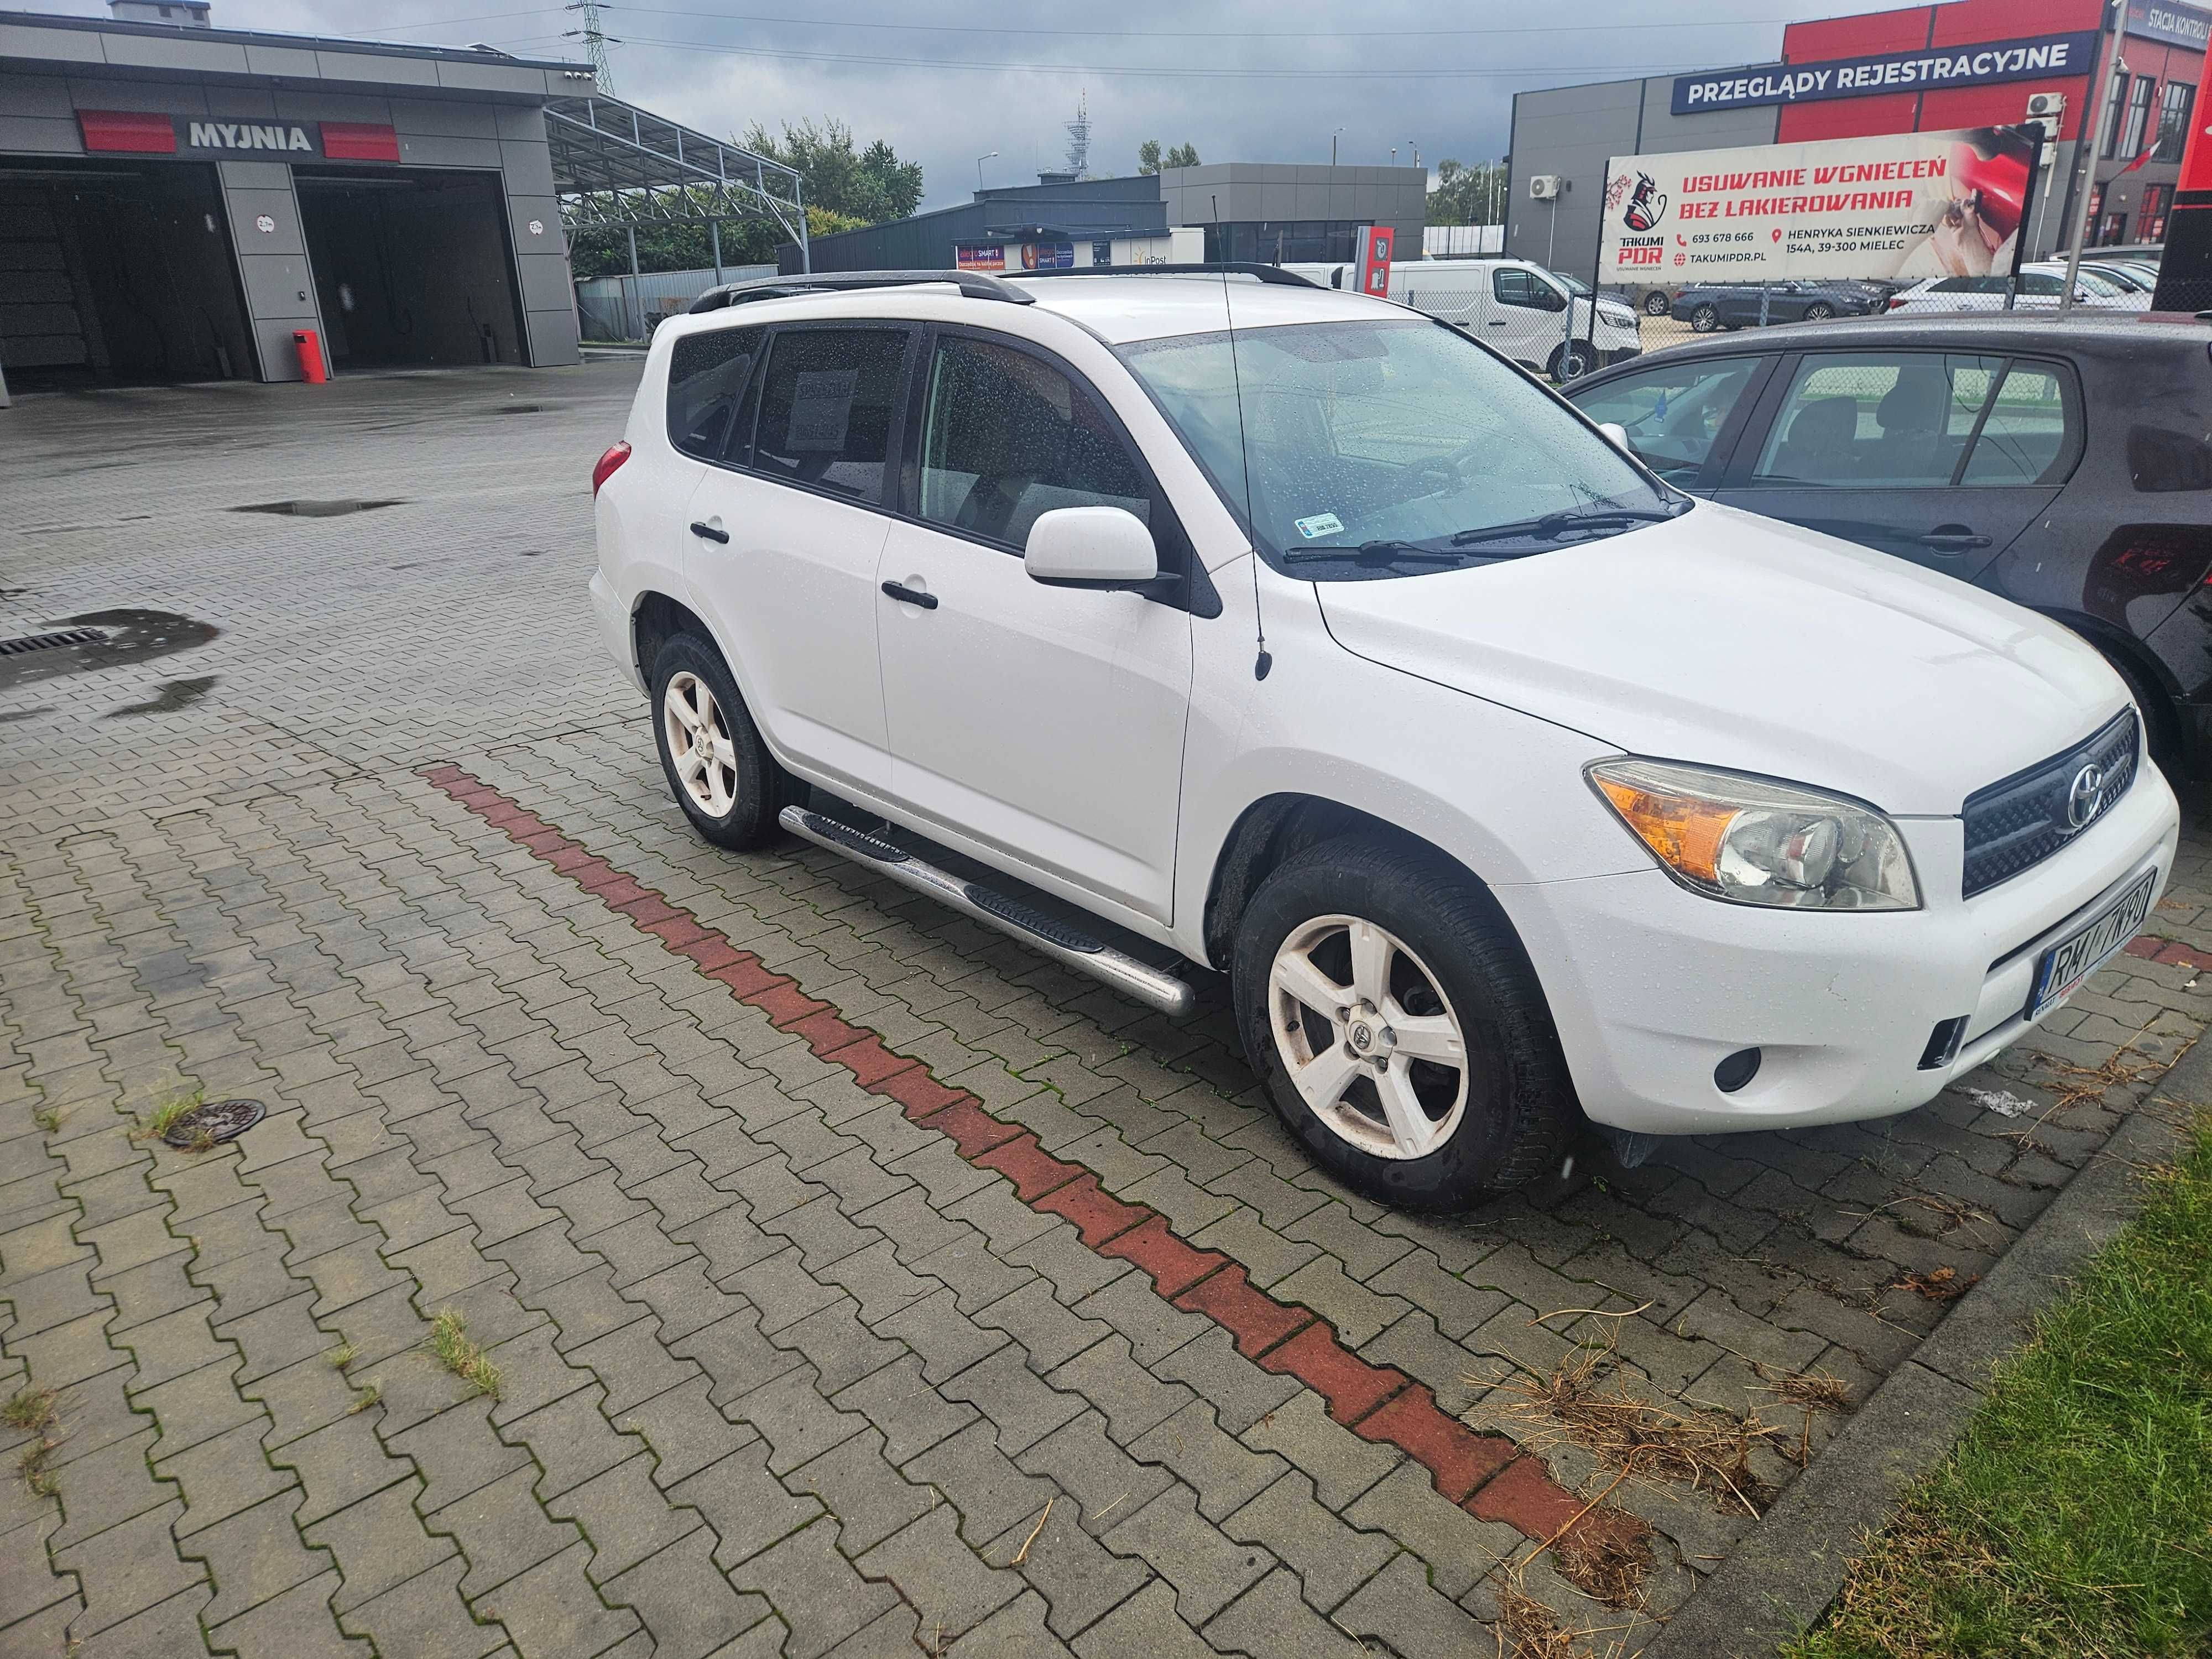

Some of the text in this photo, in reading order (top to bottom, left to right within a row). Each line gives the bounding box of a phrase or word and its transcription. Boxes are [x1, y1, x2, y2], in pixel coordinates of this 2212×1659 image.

[2148, 8, 2175, 32] STACJA
[2176, 15, 2209, 40] KONTROLI
[1688, 43, 2069, 104] PRZEGLĄDY REJESTRACYJNE
[190, 122, 312, 150] MYJNIA
[1682, 155, 1947, 194] USUWANIE WGNIECEŃ
[1679, 190, 1913, 220] BEZ LAKIEROWANIA
[1692, 232, 1754, 243] 693 678 666
[1788, 224, 1936, 239] HENRYKA SIENKIEWICZA
[1620, 236, 1664, 247] TAKUMI
[1787, 239, 1905, 254] 154A, 39-300 MIELEC
[1145, 255, 1166, 264] InPost
[1618, 247, 1663, 264] PDR
[1690, 252, 1767, 263] TAKUMIPDR.PL
